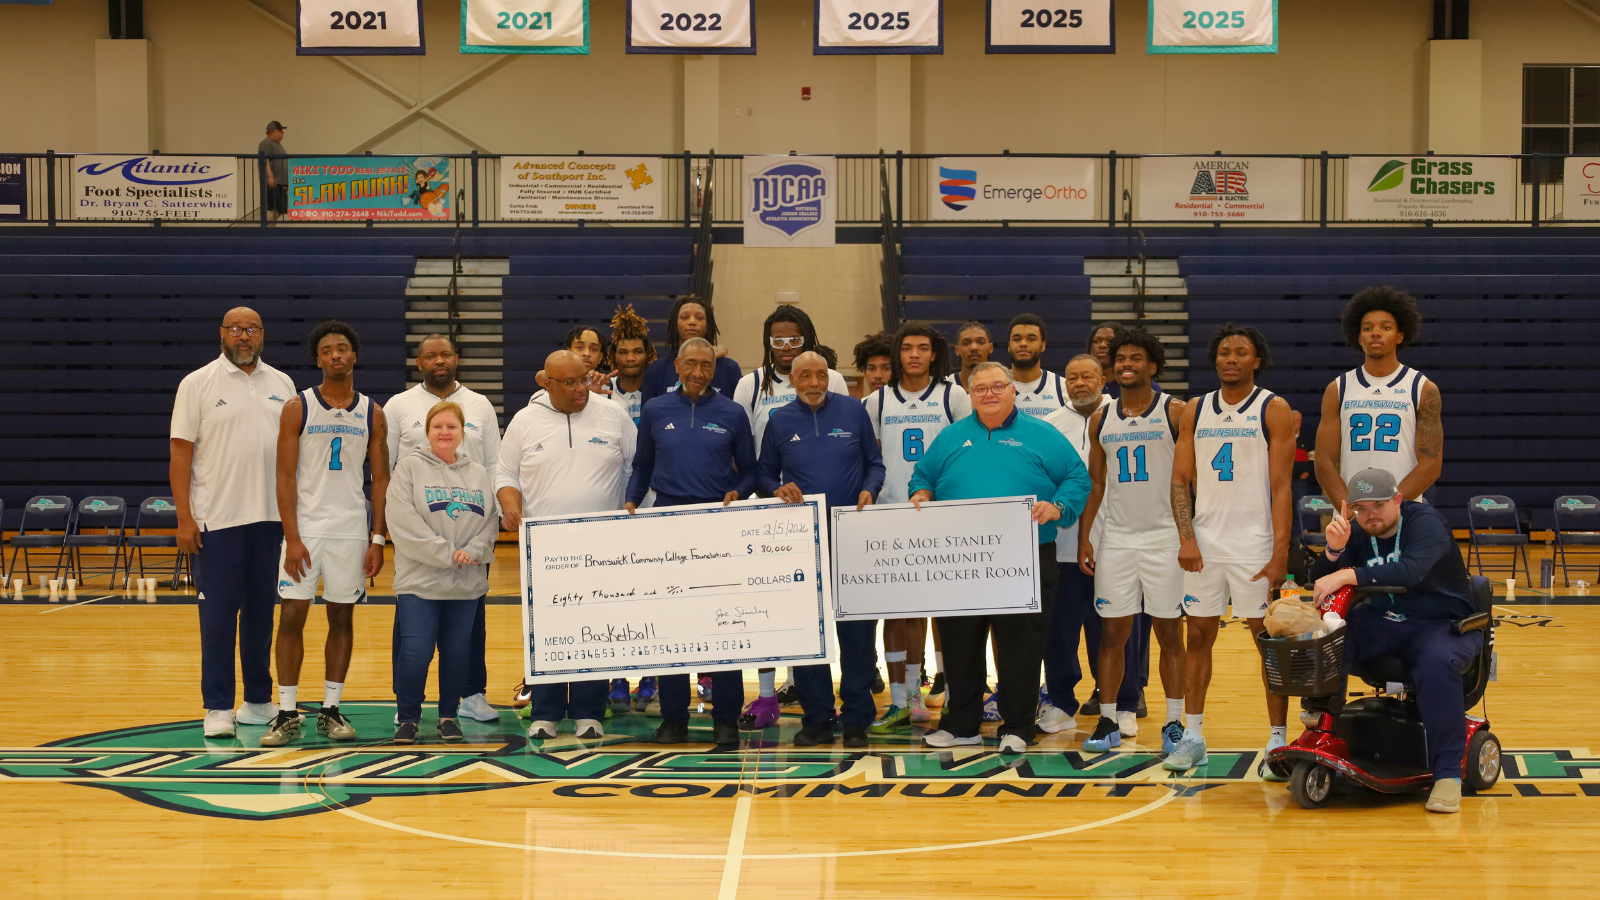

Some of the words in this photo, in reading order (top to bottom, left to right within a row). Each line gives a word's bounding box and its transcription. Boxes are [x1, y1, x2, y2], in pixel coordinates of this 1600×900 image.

[330, 11, 387, 30] 2021
[496, 11, 552, 30] 2021
[660, 12, 722, 32] 2022
[848, 12, 910, 30] 2025
[1020, 9, 1083, 28] 2025
[1182, 10, 1245, 29] 2025
[0, 163, 20, 174] ION
[78, 157, 211, 185] Atlantic
[292, 166, 318, 175] NIKI
[322, 165, 355, 175] TODD
[513, 162, 564, 170] Advanced
[568, 162, 616, 172] Concepts
[1193, 161, 1249, 170] AMERICAN
[1411, 158, 1472, 175] Grass
[532, 172, 584, 182] Southport
[586, 172, 606, 180] Inc.
[1190, 171, 1249, 194] AIR
[1410, 177, 1495, 195] Chasers
[84, 186, 122, 197] Foot
[126, 186, 212, 199] Specialists
[294, 182, 346, 206] SLAM
[350, 175, 409, 200] DUNK!
[752, 178, 826, 212] NJCAA
[983, 185, 1087, 202] EmergeOrtho
[104, 200, 139, 208] Bryan
[162, 200, 233, 208] Satterwhite
[762, 394, 796, 406] BRUNS
[1344, 400, 1410, 412] BRUNSWICK
[885, 414, 942, 425] BRUNSWICK
[308, 424, 366, 437] BRUNSWICK
[1103, 431, 1164, 444] BRUNSWICK
[1197, 428, 1258, 439] BRUNSWICK
[1350, 413, 1402, 452] 22
[329, 436, 342, 470] 1
[903, 428, 924, 462] 6
[1116, 445, 1149, 483] 11
[1211, 442, 1234, 482] 4
[425, 489, 484, 508] DOLPHINS
[742, 529, 760, 537] DATE
[763, 520, 808, 540] 2/5/2026
[747, 544, 753, 554] $
[761, 545, 792, 554] 80,000
[892, 538, 903, 550] &
[585, 554, 628, 568] Brunswick
[630, 552, 664, 564] Community
[665, 551, 688, 564] College
[690, 548, 732, 561] Foundation
[748, 575, 792, 586] DOLLARS
[552, 593, 583, 607] Eighty
[592, 588, 635, 598] Thousand
[545, 636, 574, 646] MEMO
[582, 623, 656, 642] Basketball
[553, 783, 1225, 798] COMMUNITY
